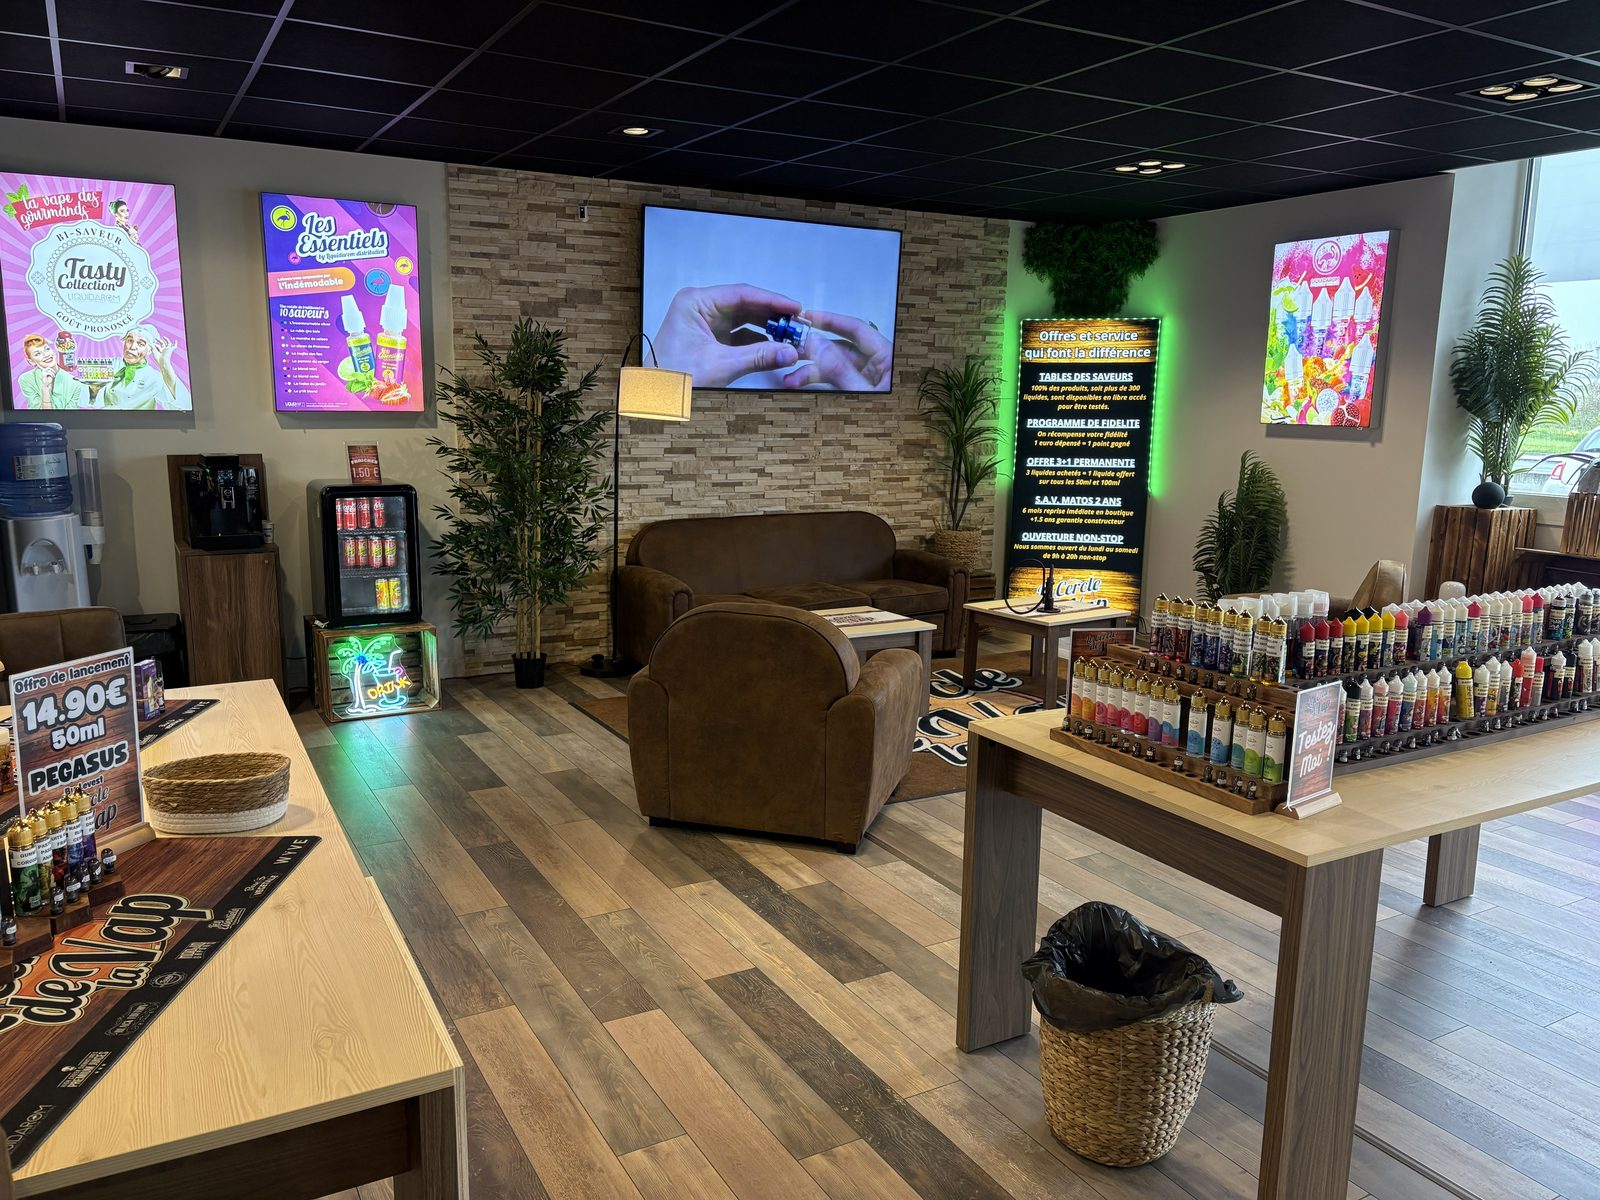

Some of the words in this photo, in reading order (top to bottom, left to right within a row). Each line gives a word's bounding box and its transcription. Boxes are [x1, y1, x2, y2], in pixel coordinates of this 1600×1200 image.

[42, 193, 74, 209] vape
[78, 187, 99, 208] des
[20, 203, 89, 230] gourmands
[304, 214, 332, 236] Les
[56, 228, 122, 246] BI-SAVEUR
[298, 230, 386, 254] Essentiels
[58, 274, 116, 291] Collection
[64, 258, 126, 288] Tasty
[67, 293, 120, 303] LIQUIDAROM
[56, 311, 81, 329] GOÛT
[84, 313, 135, 333] PRONONCÉ
[280, 308, 288, 316] 10
[289, 309, 329, 319] saveurs
[1040, 331, 1077, 341] Offres
[1079, 332, 1092, 340] et
[1095, 331, 1138, 340] service
[1025, 348, 1043, 360] qui
[1047, 348, 1072, 357] font
[1074, 348, 1085, 358] la
[1088, 348, 1151, 358] différence
[1039, 373, 1072, 382] TABLES
[1074, 373, 1091, 382] DES
[1092, 373, 1133, 382] SAVEURS
[1027, 419, 1085, 428] PROGRAMME
[1088, 419, 1100, 428] DE
[1102, 419, 1140, 428] FIDELITE
[352, 467, 370, 478] 1.50
[374, 467, 379, 478] €
[1027, 457, 1055, 466] OFFRE
[1057, 458, 1072, 466] 3+1
[1073, 458, 1135, 468] PERMANENTE
[1035, 496, 1060, 505] S.A.V.
[1062, 496, 1094, 505] MATOS
[1095, 497, 1101, 505] 2
[1103, 498, 1121, 506] ANS
[1022, 532, 1074, 541] OUVERTURE
[1077, 534, 1124, 544] NON-STOP
[1056, 577, 1100, 596] Cercle
[14, 676, 47, 694] Offre
[51, 671, 66, 685] de
[70, 654, 130, 680] lancement
[367, 676, 411, 699] DRINK
[22, 677, 127, 732] 14.90€
[52, 717, 106, 750] 50ml
[1298, 721, 1336, 754] Testez
[30, 742, 129, 794] PEGASUS
[1300, 748, 1322, 778] Moi
[49, 894, 214, 978] Vap
[96, 966, 152, 990] la
[6, 979, 98, 1024] de
